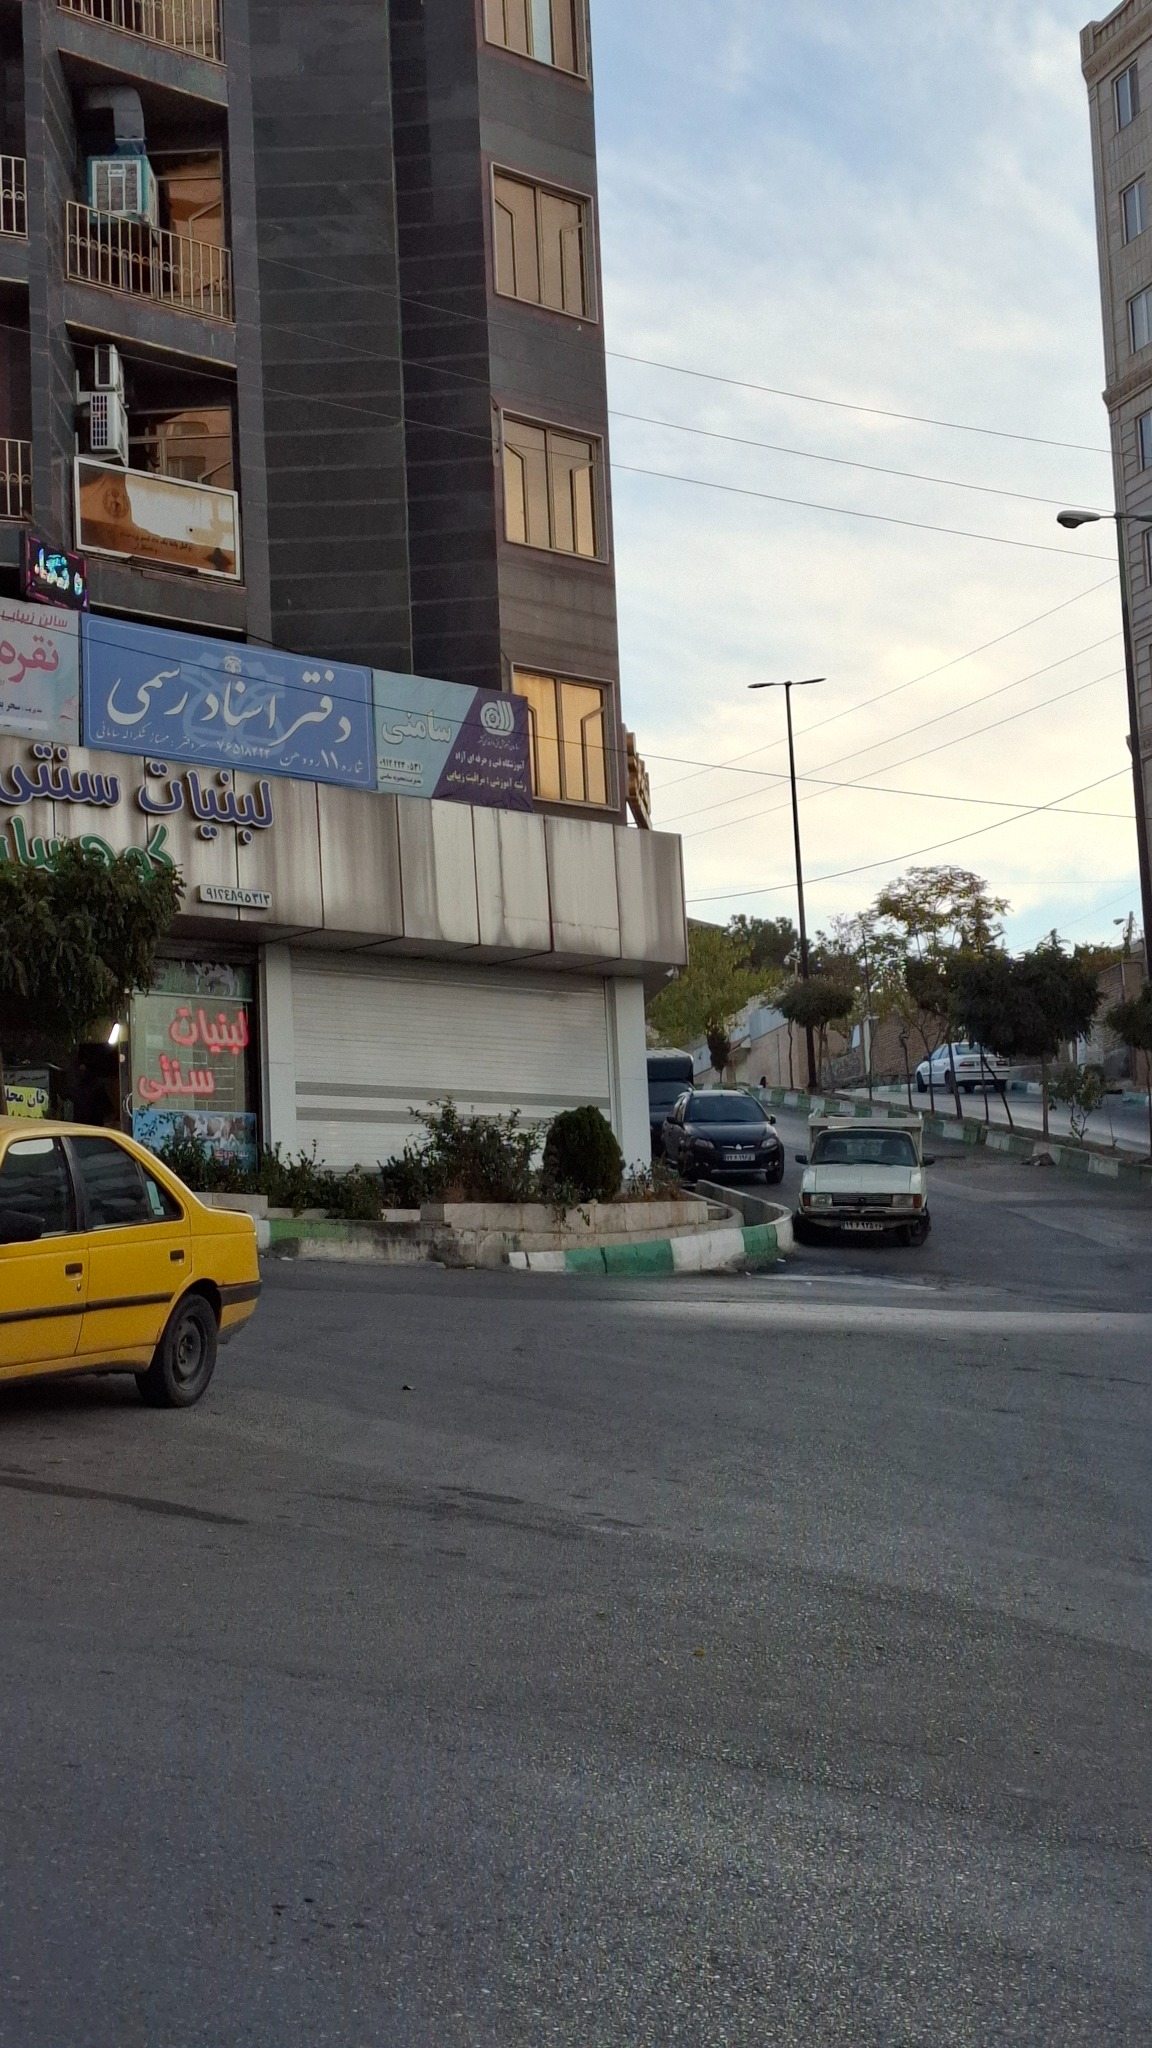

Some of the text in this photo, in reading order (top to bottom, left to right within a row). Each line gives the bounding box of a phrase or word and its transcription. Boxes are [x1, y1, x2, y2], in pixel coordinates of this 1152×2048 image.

[39, 612, 68, 628] سالن
[0, 634, 59, 684] نقره
[107, 667, 352, 747] دفتر اسناد رسمی
[341, 759, 364, 774] شماره
[0, 743, 274, 845] لبنیات سنتی
[169, 1007, 249, 1056] لبنیات
[138, 1054, 215, 1101] سنتی
